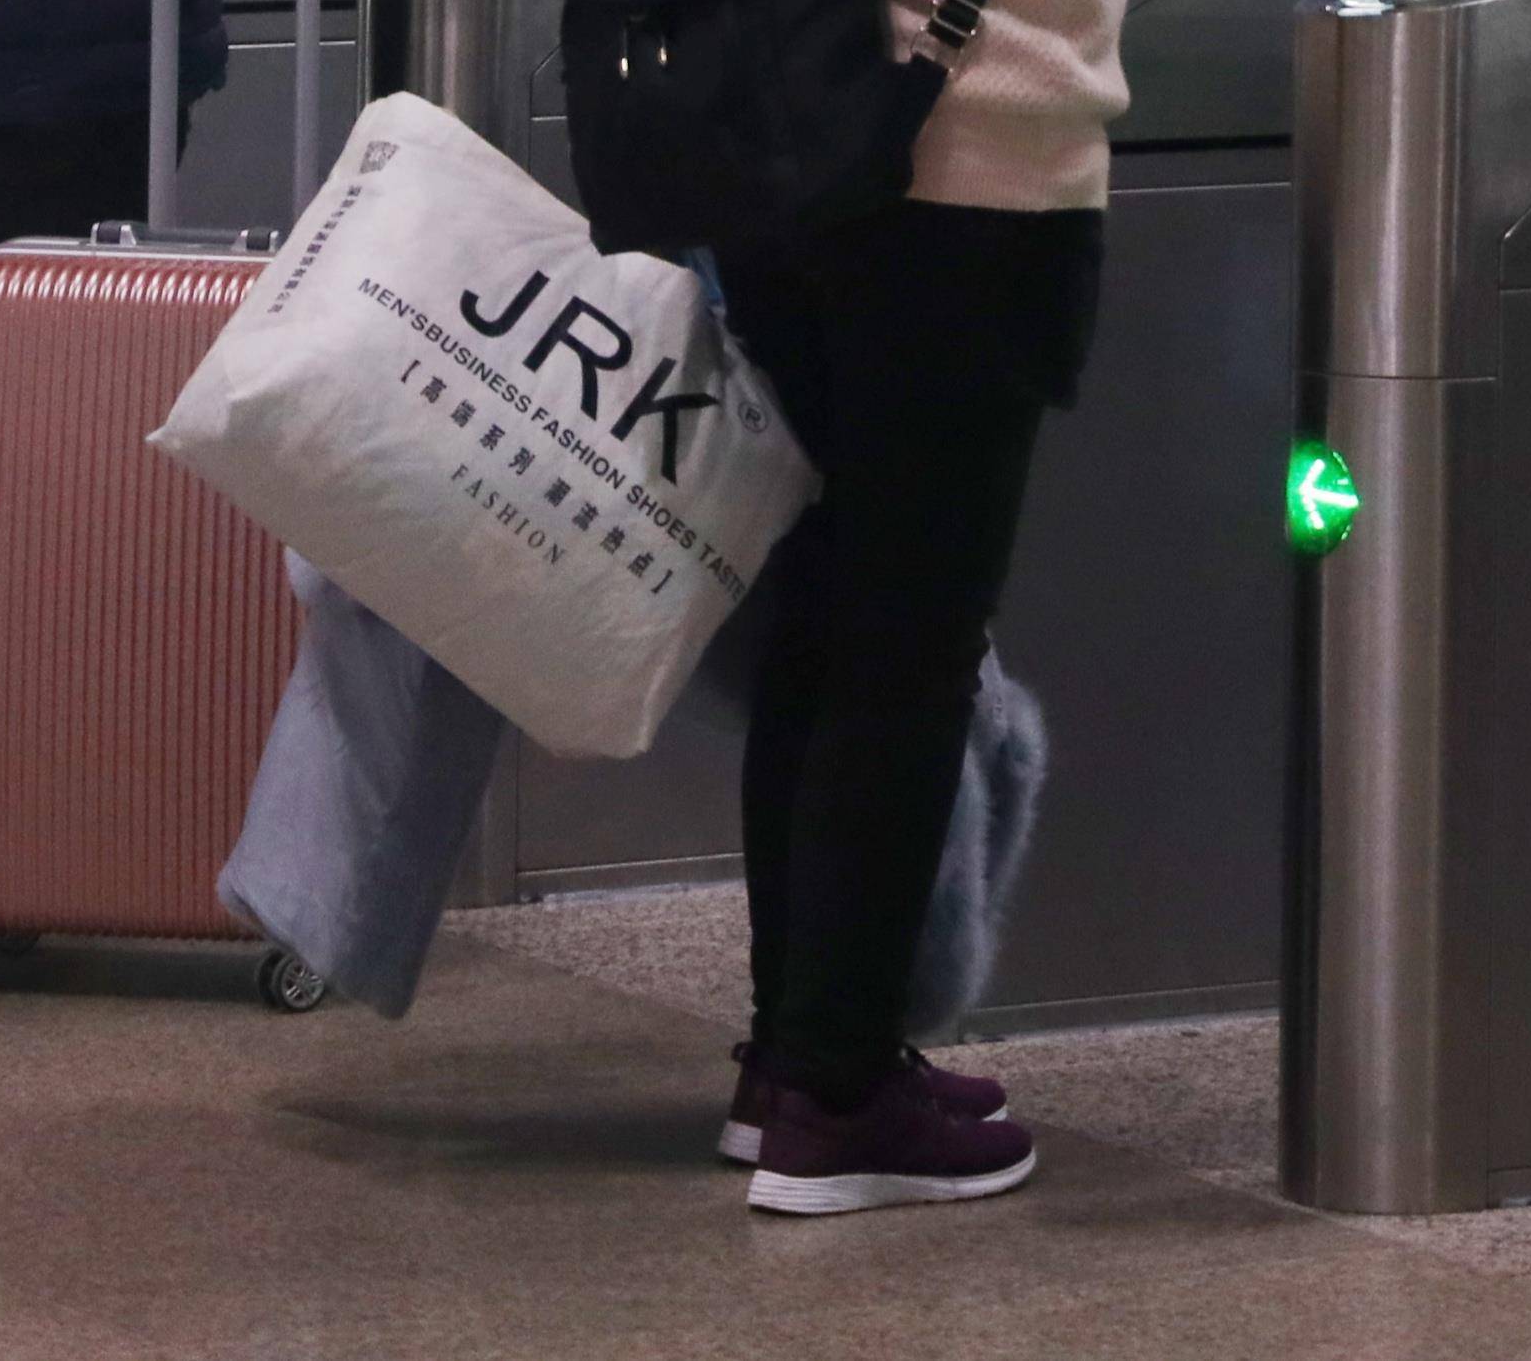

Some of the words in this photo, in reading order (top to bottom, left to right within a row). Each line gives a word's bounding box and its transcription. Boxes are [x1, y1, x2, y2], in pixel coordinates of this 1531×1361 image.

[459, 269, 719, 485] JRK
[449, 463, 567, 567] FASHION
[530, 408, 626, 490] FASHION
[625, 483, 697, 549] SHOES
